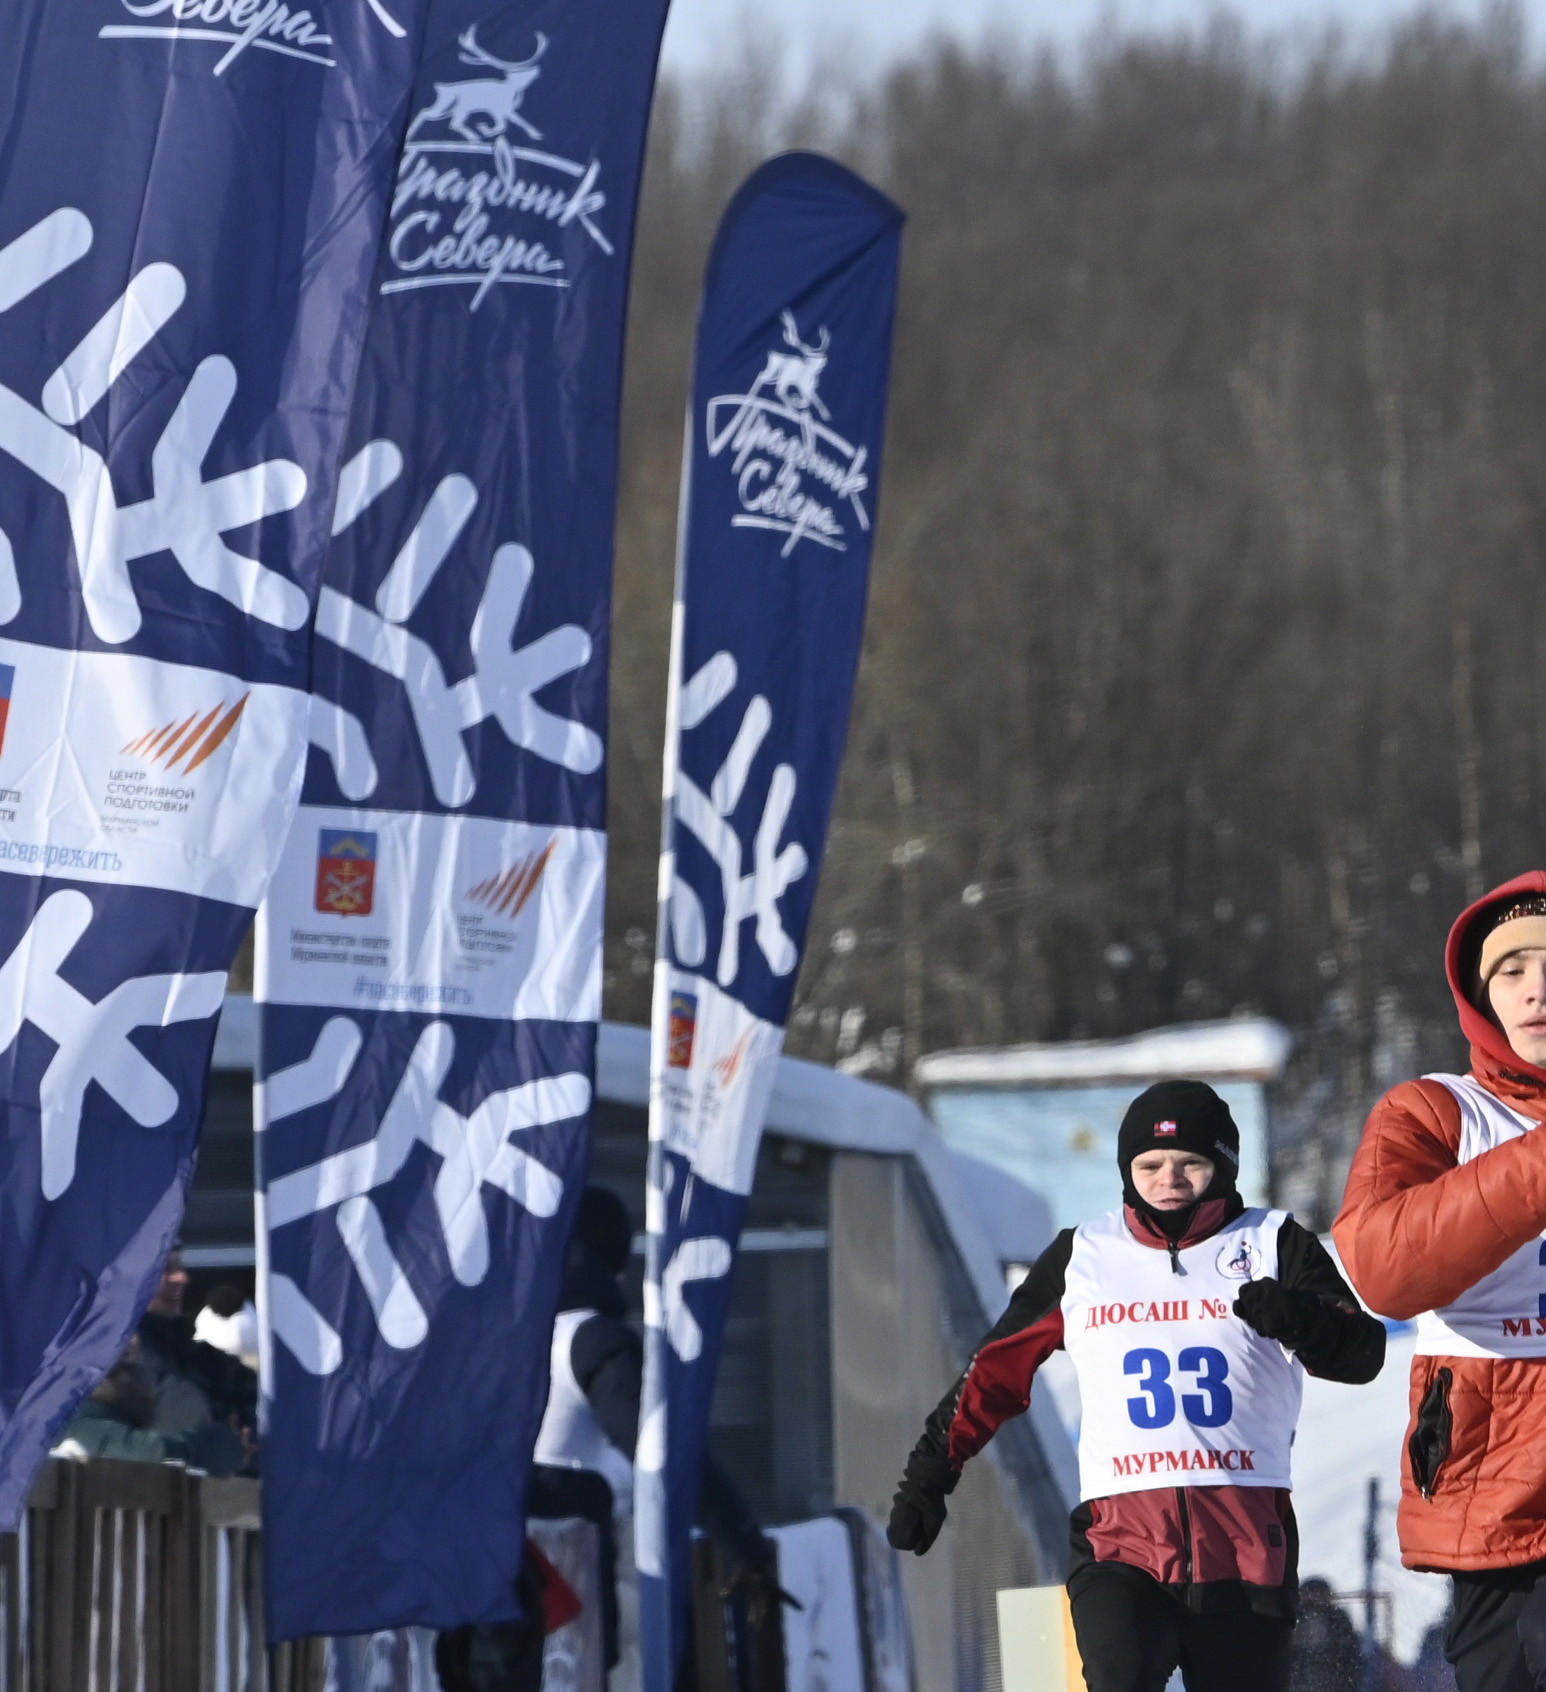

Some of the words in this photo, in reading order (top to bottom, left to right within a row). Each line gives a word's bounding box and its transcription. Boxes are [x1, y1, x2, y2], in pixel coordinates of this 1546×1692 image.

[388, 211, 566, 314] Севера
[706, 394, 871, 533] Праздник
[738, 459, 846, 559] Севера
[106, 783, 195, 800] СПОРТИВНОЙ
[108, 769, 147, 781] ЦЕНТР
[104, 796, 189, 813] ПОДГОТОВКИ
[1084, 1299, 1190, 1332] ДЮСАШ
[1198, 1298, 1228, 1320] №
[1123, 1346, 1234, 1430] 33
[1112, 1449, 1256, 1478] МУРМАНСК
